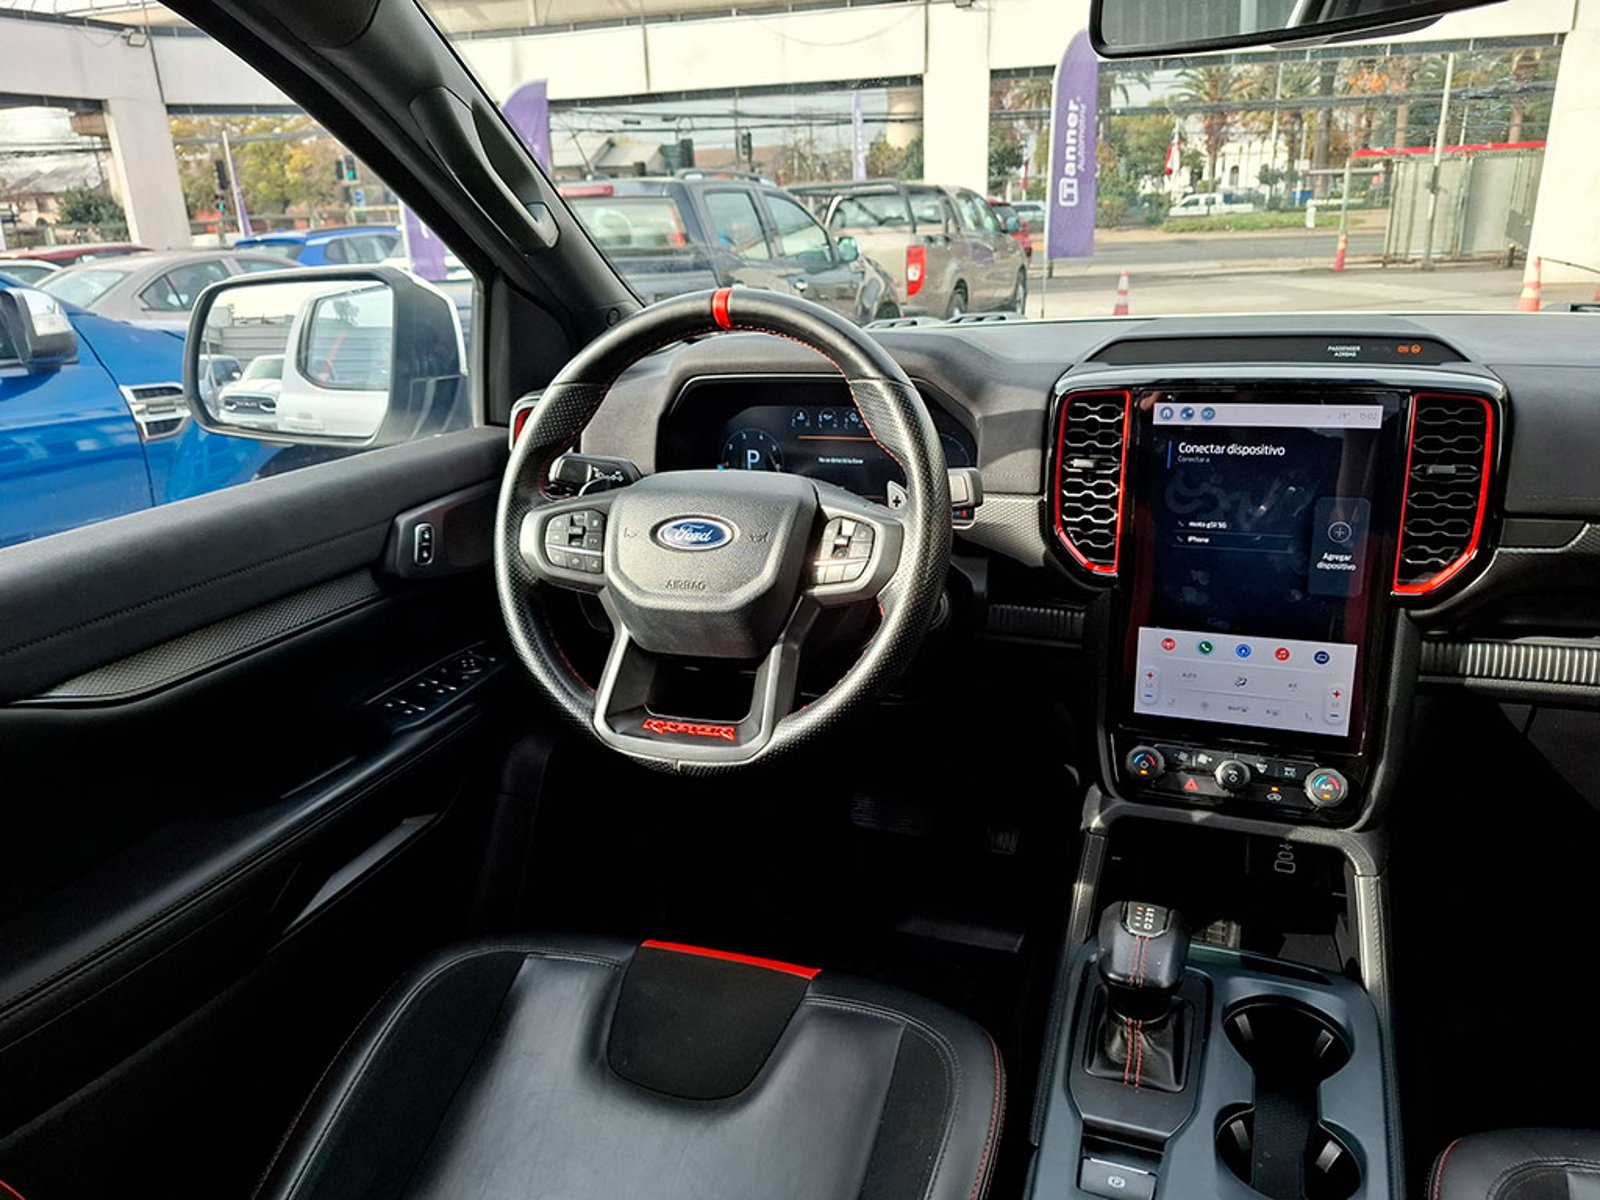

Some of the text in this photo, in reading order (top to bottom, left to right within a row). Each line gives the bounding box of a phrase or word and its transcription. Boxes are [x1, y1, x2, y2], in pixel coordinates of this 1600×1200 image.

[1178, 441, 1286, 457] Conectar dispositivo
[746, 449, 760, 469] P
[674, 524, 715, 542] Ford
[1187, 535, 1210, 543] iPhone
[1322, 552, 1353, 562] Agregar
[1316, 561, 1357, 571] dispositivo
[665, 579, 707, 590] AIRBAG
